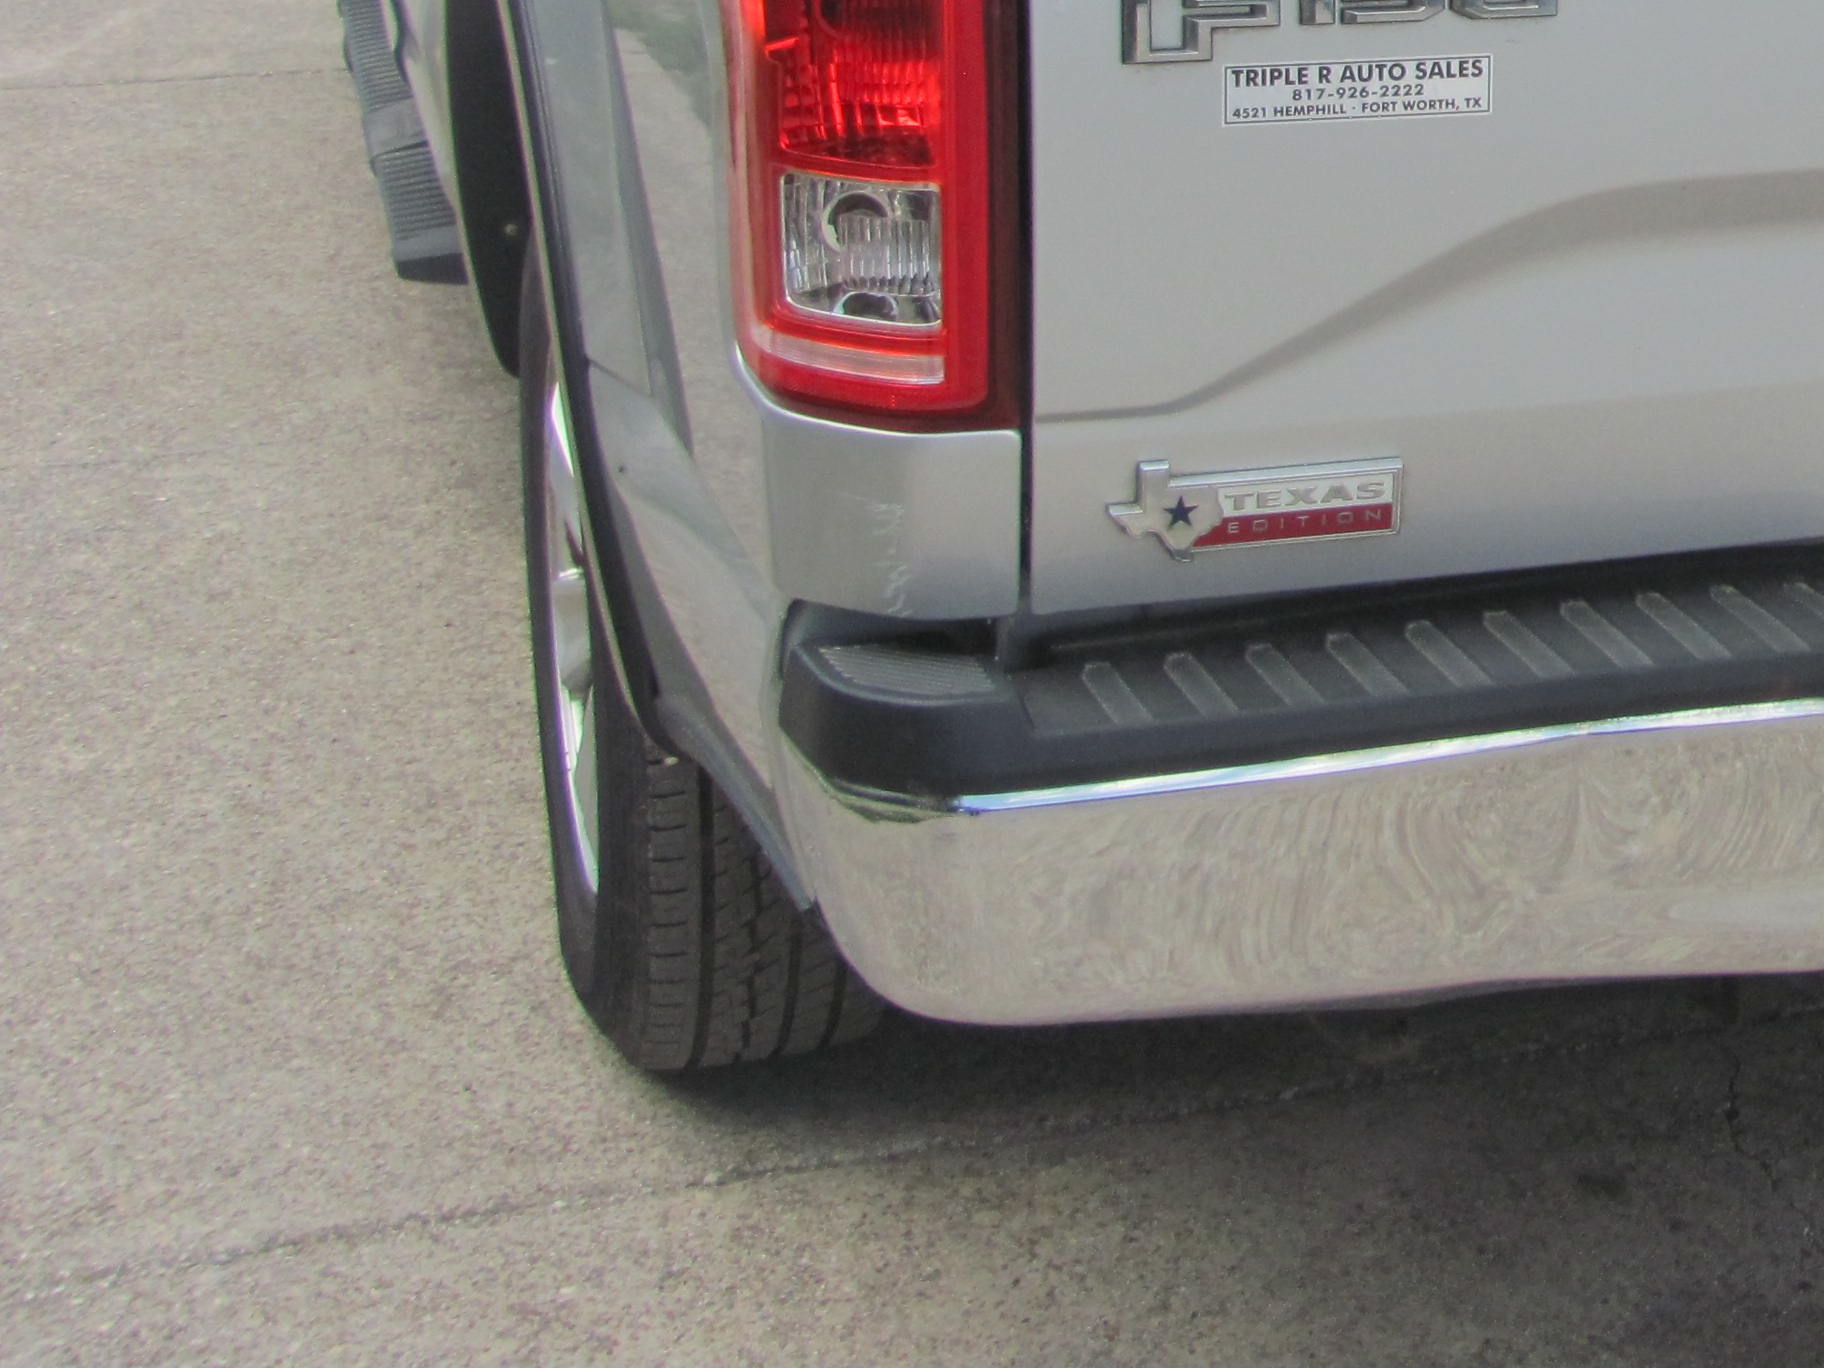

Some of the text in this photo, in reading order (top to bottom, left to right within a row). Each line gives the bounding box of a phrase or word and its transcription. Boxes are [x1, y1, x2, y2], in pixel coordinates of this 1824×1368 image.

[1231, 59, 1484, 88] TRIPLE R AUTO SALES
[1291, 83, 1425, 101] 817-926-2222
[1231, 97, 1482, 120] 4521 HEMPHILL FORT WORTH, TX
[1223, 481, 1386, 512] TEXAS
[1227, 508, 1383, 534] EDITION
